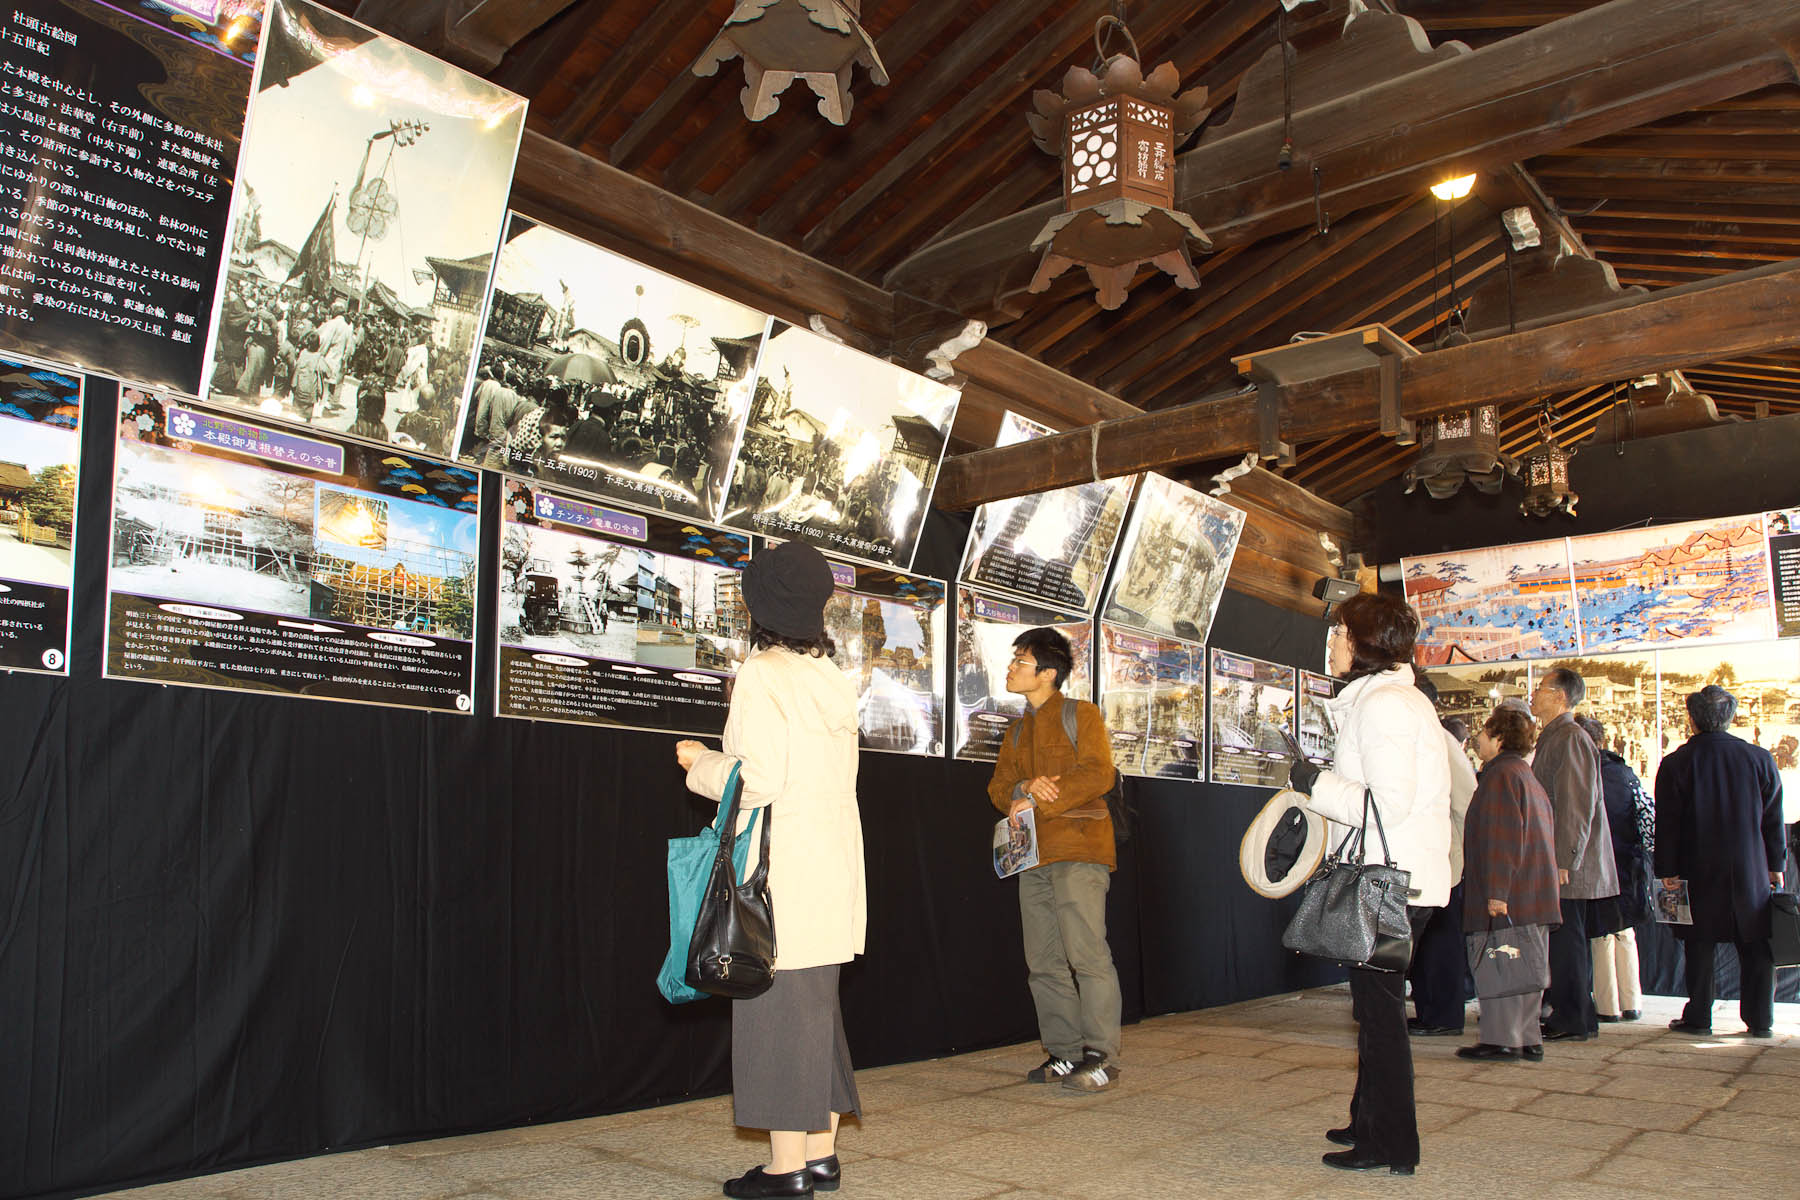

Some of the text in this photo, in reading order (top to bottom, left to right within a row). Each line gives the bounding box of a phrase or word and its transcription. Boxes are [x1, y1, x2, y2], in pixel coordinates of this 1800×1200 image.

[0, 26, 50, 56] 十五世紀
[12, 9, 78, 47] 社頭古絵図
[0, 59, 224, 153] た本殿を中心とし、その外側に多数の摂末社
[0, 243, 151, 297] 描かれているのも注意を引く。
[500, 446, 597, 480] 明治三十五年(1902)
[48, 653, 56, 665] 8
[460, 697, 466, 707] 7
